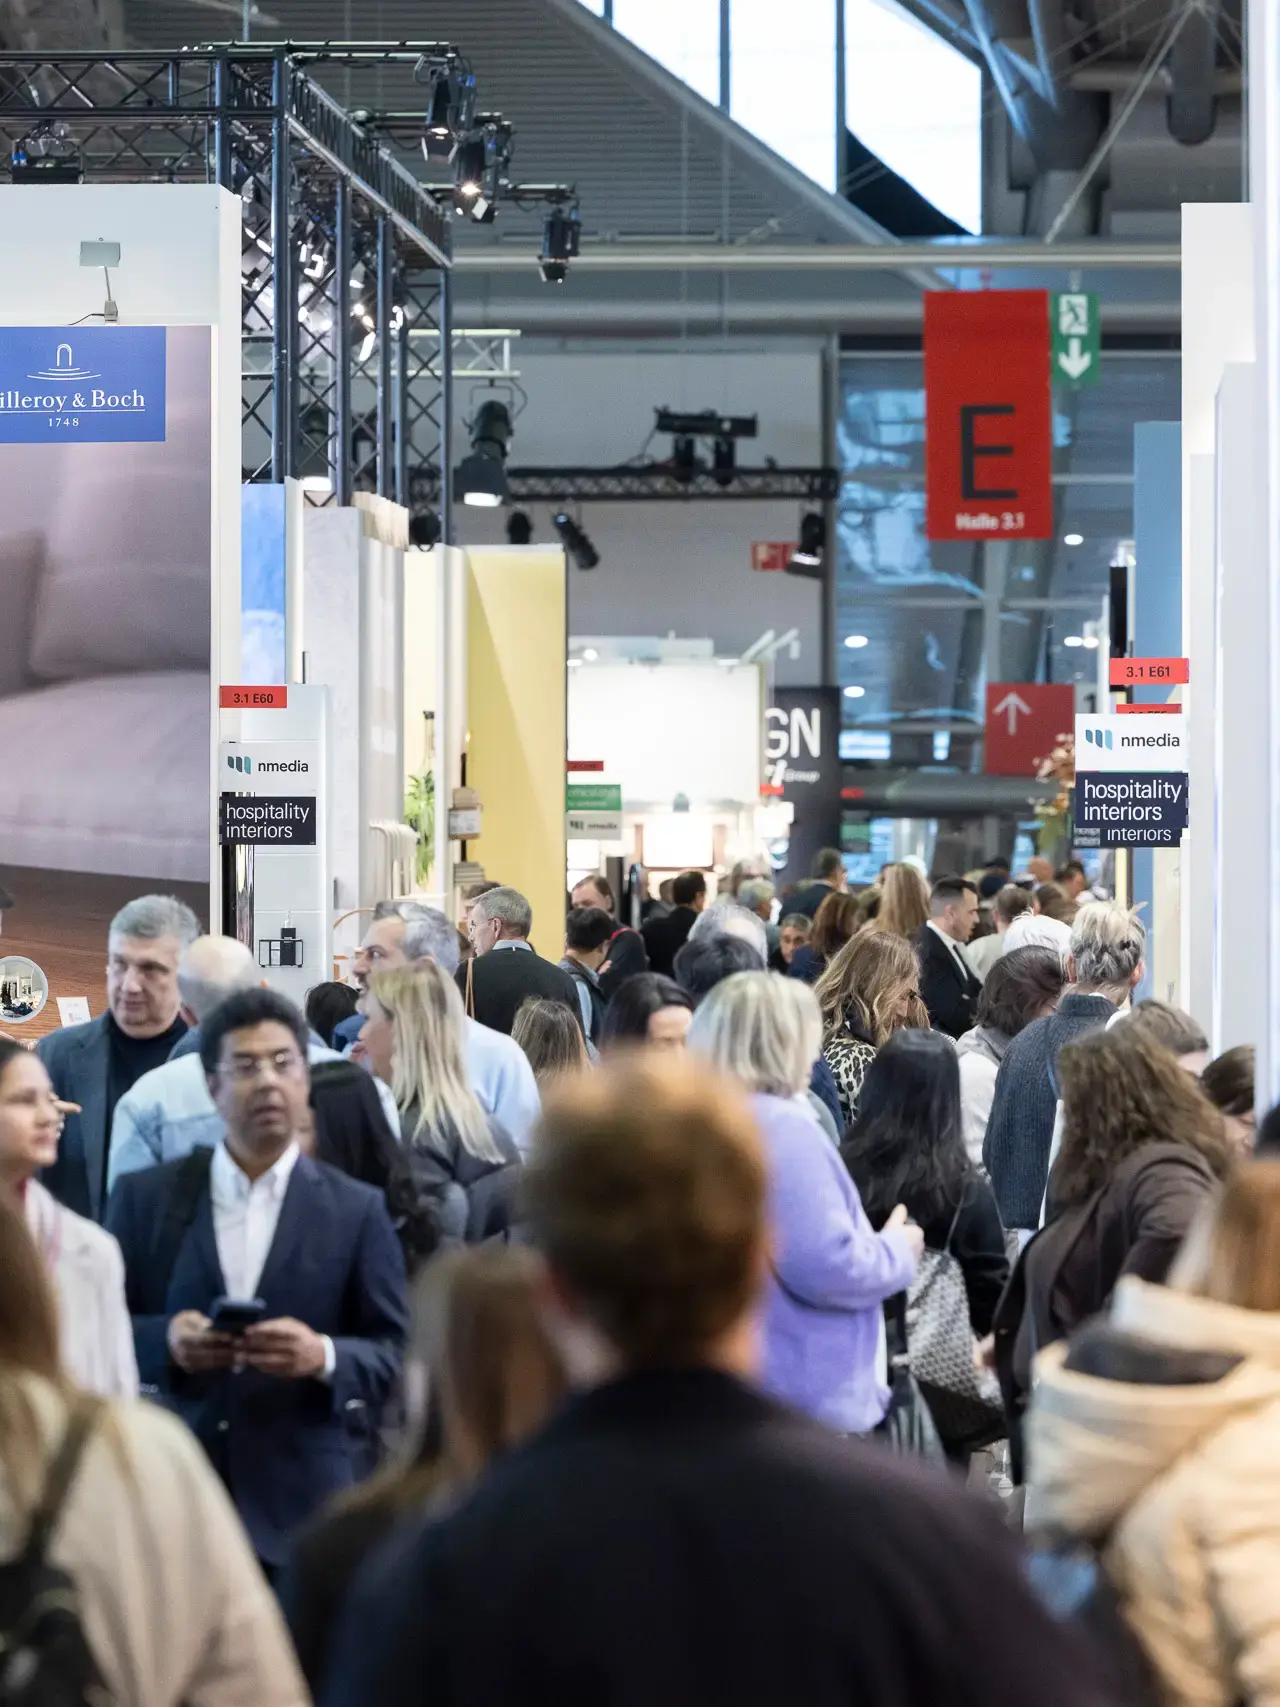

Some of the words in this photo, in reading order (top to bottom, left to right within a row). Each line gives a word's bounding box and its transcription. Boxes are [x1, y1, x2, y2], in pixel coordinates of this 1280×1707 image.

[72, 392, 86, 408] &
[91, 389, 146, 407] Boch
[48, 417, 80, 427] 1748
[961, 405, 1018, 499] E
[955, 512, 999, 530] Halle
[1001, 511, 1025, 530] 3.1
[1126, 666, 1144, 678] 3.1
[1149, 665, 1171, 678] E61
[233, 693, 249, 704] 3.1
[252, 693, 274, 704] E60
[1121, 733, 1180, 747] nmedia
[258, 760, 309, 772] nmedia
[1084, 779, 1182, 803] hospitality
[226, 803, 310, 823] hospitality
[1084, 802, 1163, 821] interiors
[226, 822, 293, 839] interiors
[1107, 828, 1172, 841] interiors
